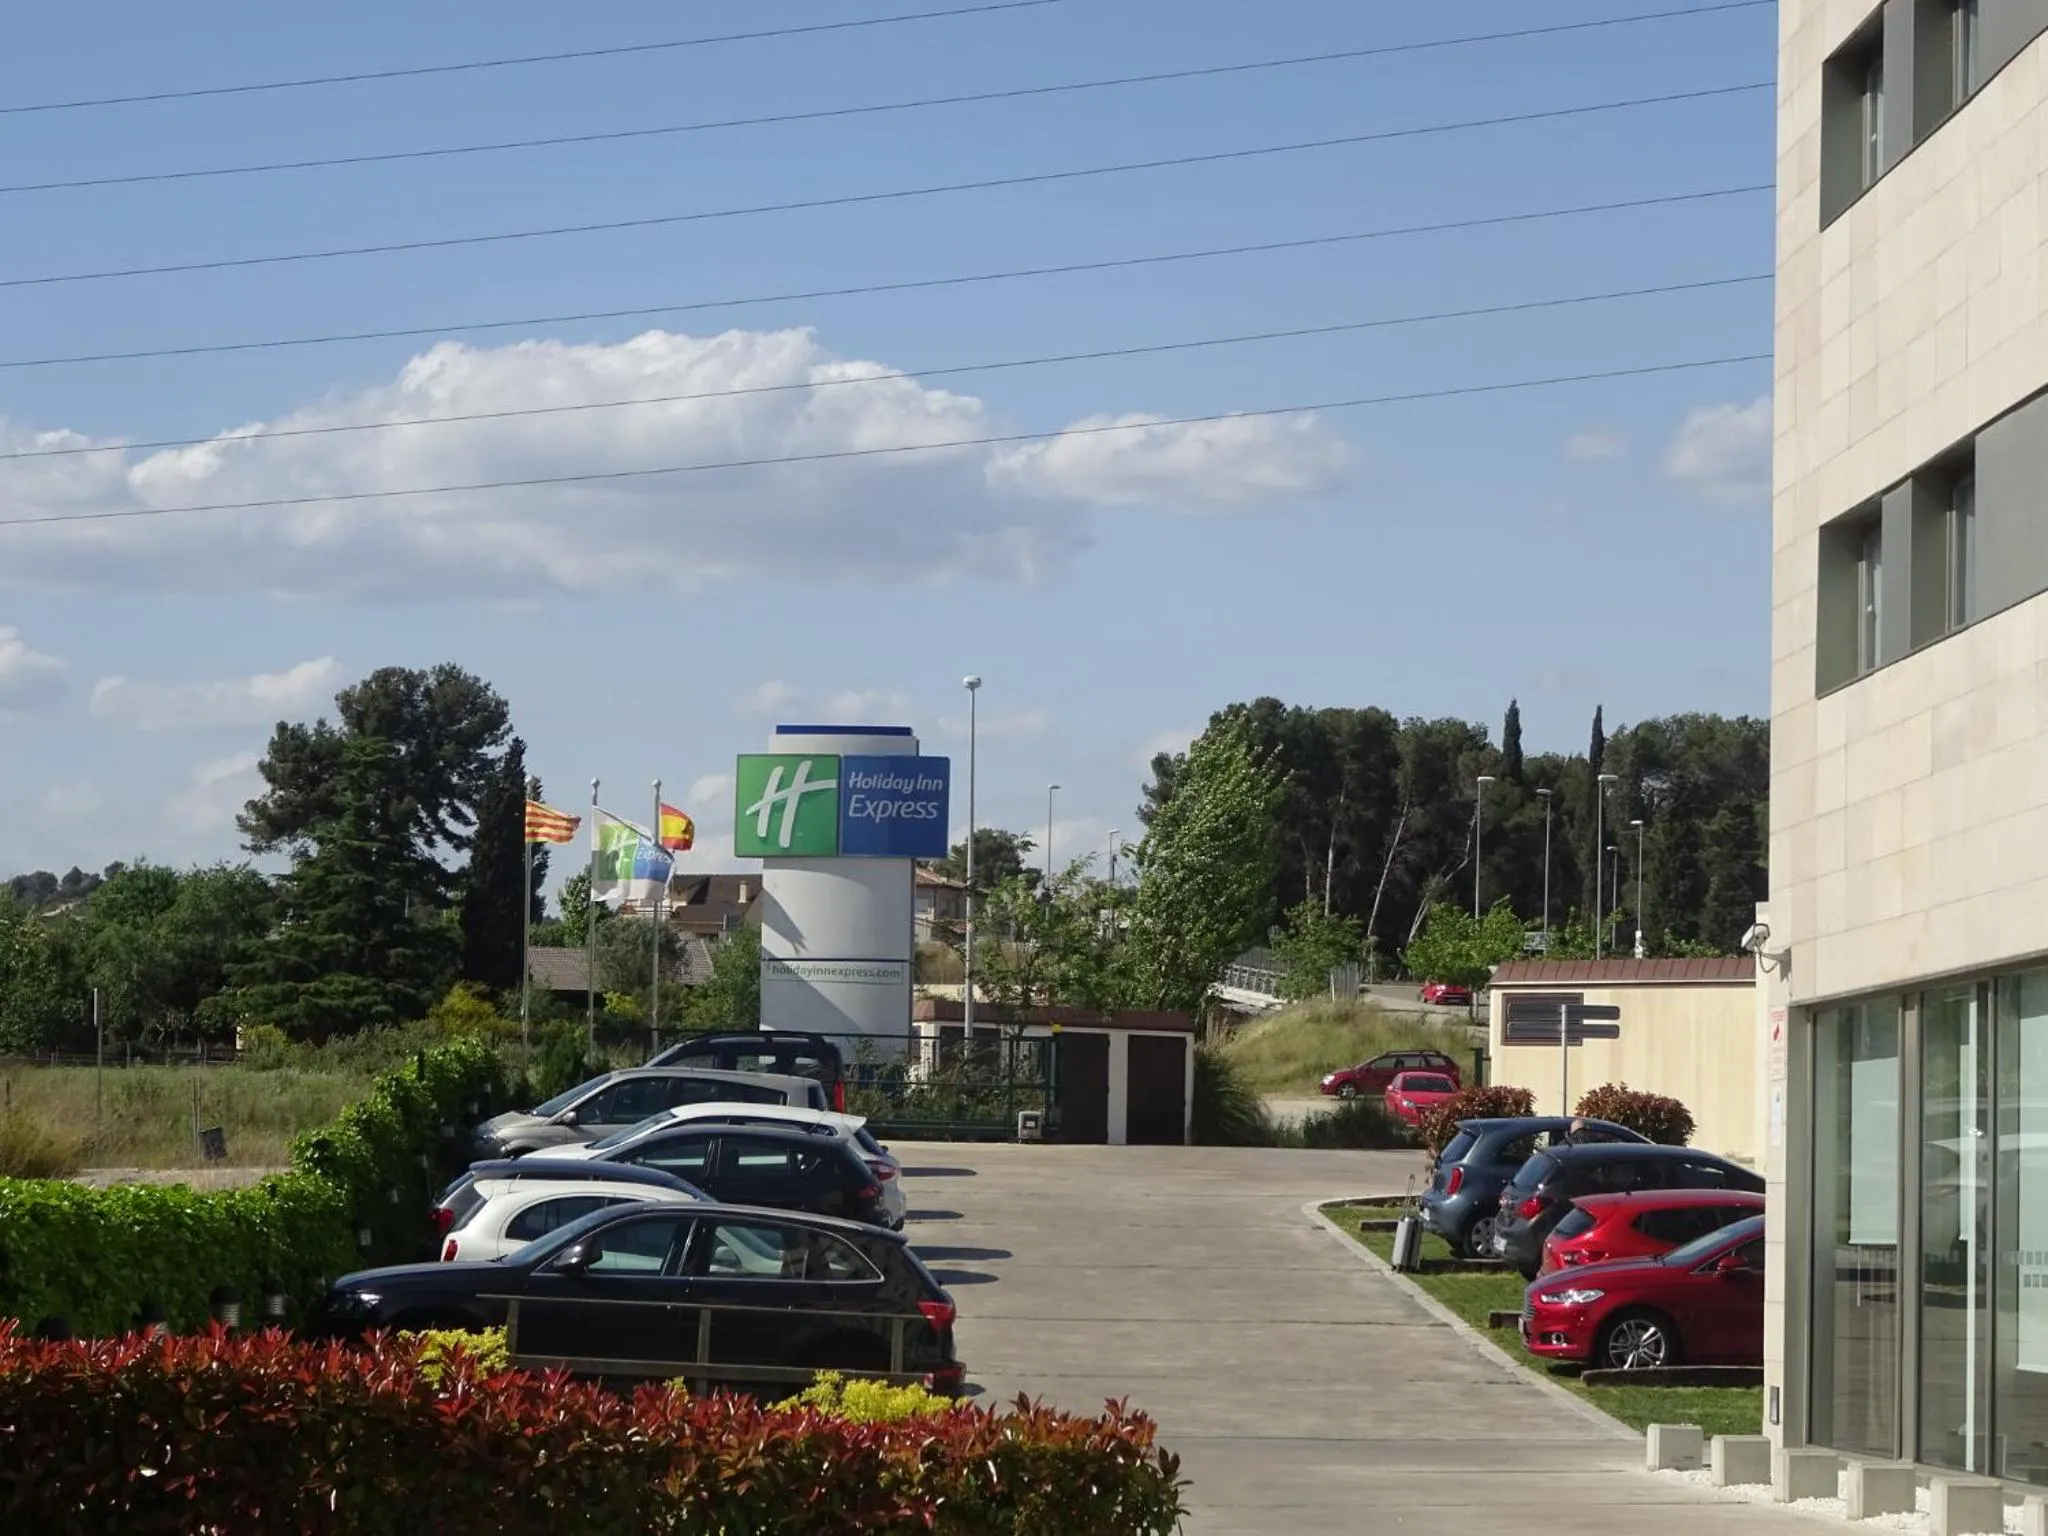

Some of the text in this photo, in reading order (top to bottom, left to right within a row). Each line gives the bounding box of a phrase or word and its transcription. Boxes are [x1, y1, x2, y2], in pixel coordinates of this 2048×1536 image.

[849, 771, 944, 794] Holiday Inn
[848, 794, 939, 824] Express
[772, 963, 901, 979] holidayinnexpress.com
